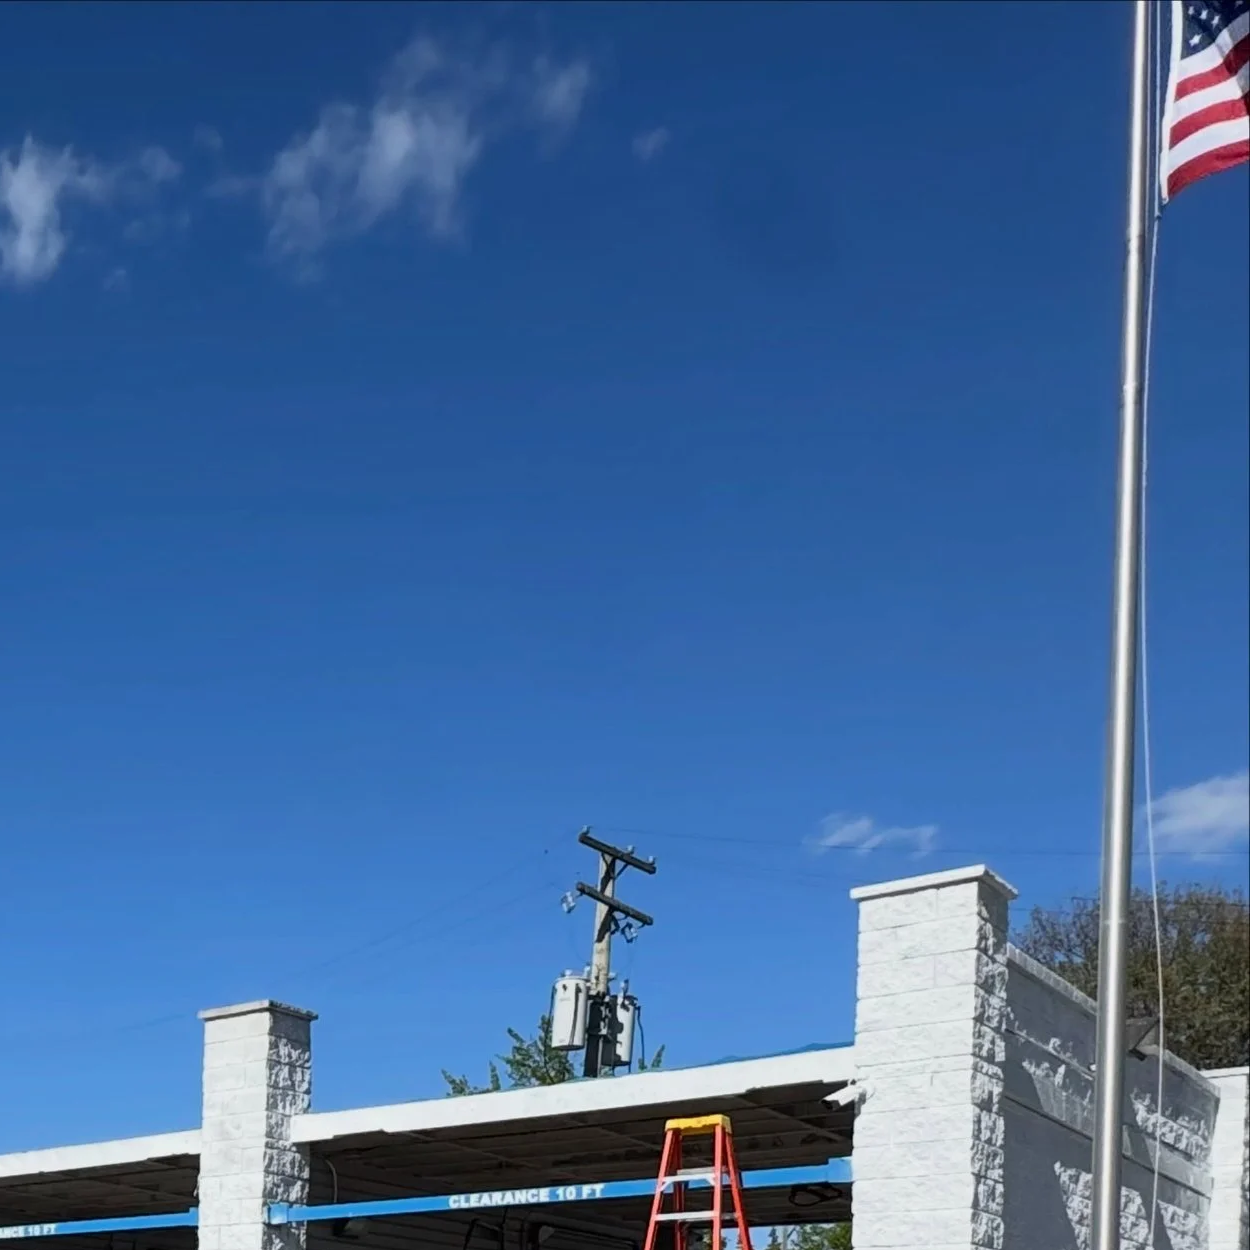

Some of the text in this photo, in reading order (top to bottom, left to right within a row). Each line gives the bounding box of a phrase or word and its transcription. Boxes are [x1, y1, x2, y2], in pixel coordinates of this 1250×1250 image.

[449, 1184, 604, 1209] CLEARANCE 10 FT
